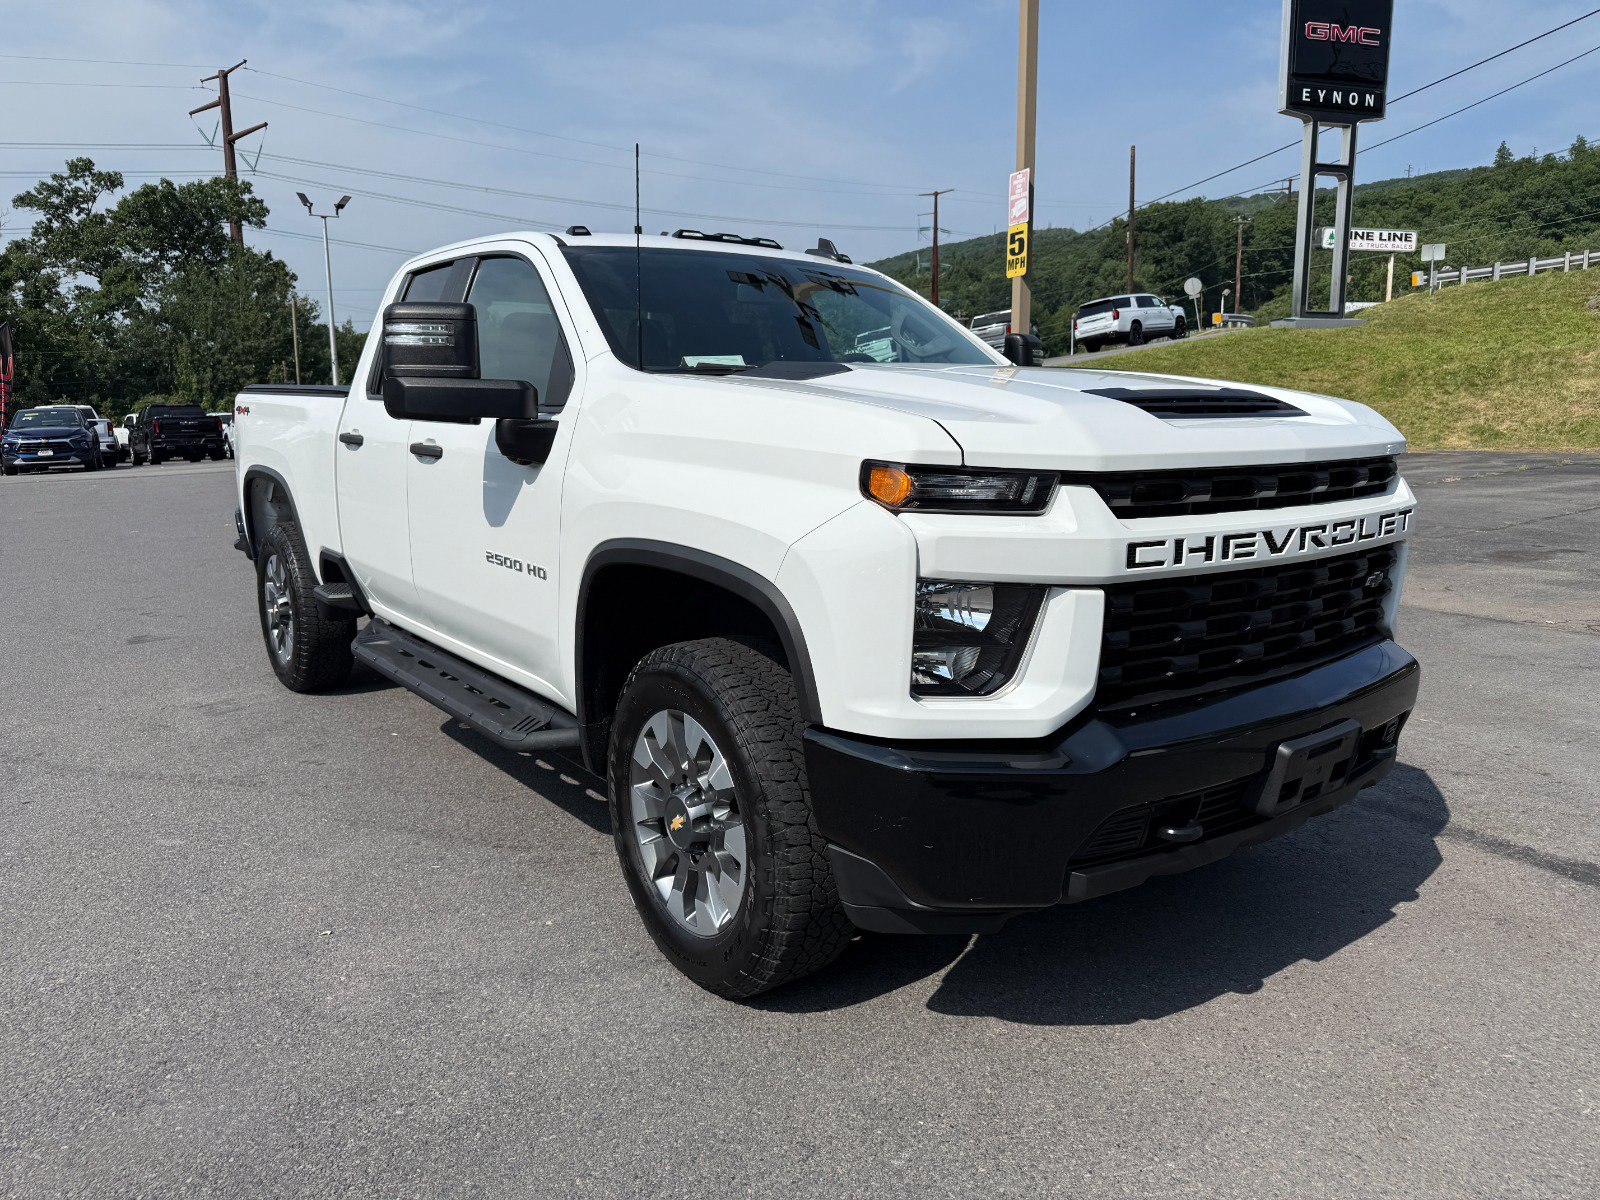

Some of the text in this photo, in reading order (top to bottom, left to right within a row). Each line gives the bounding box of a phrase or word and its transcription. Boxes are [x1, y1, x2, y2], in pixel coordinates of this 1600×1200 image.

[1305, 22, 1380, 46] GMC
[1302, 88, 1375, 107] EYNON
[1009, 230, 1025, 257] 5
[1350, 231, 1413, 242] INE LINE
[1008, 256, 1025, 271] MPH
[1126, 508, 1414, 571] CHEVROLET
[485, 550, 547, 581] 2500 HD
